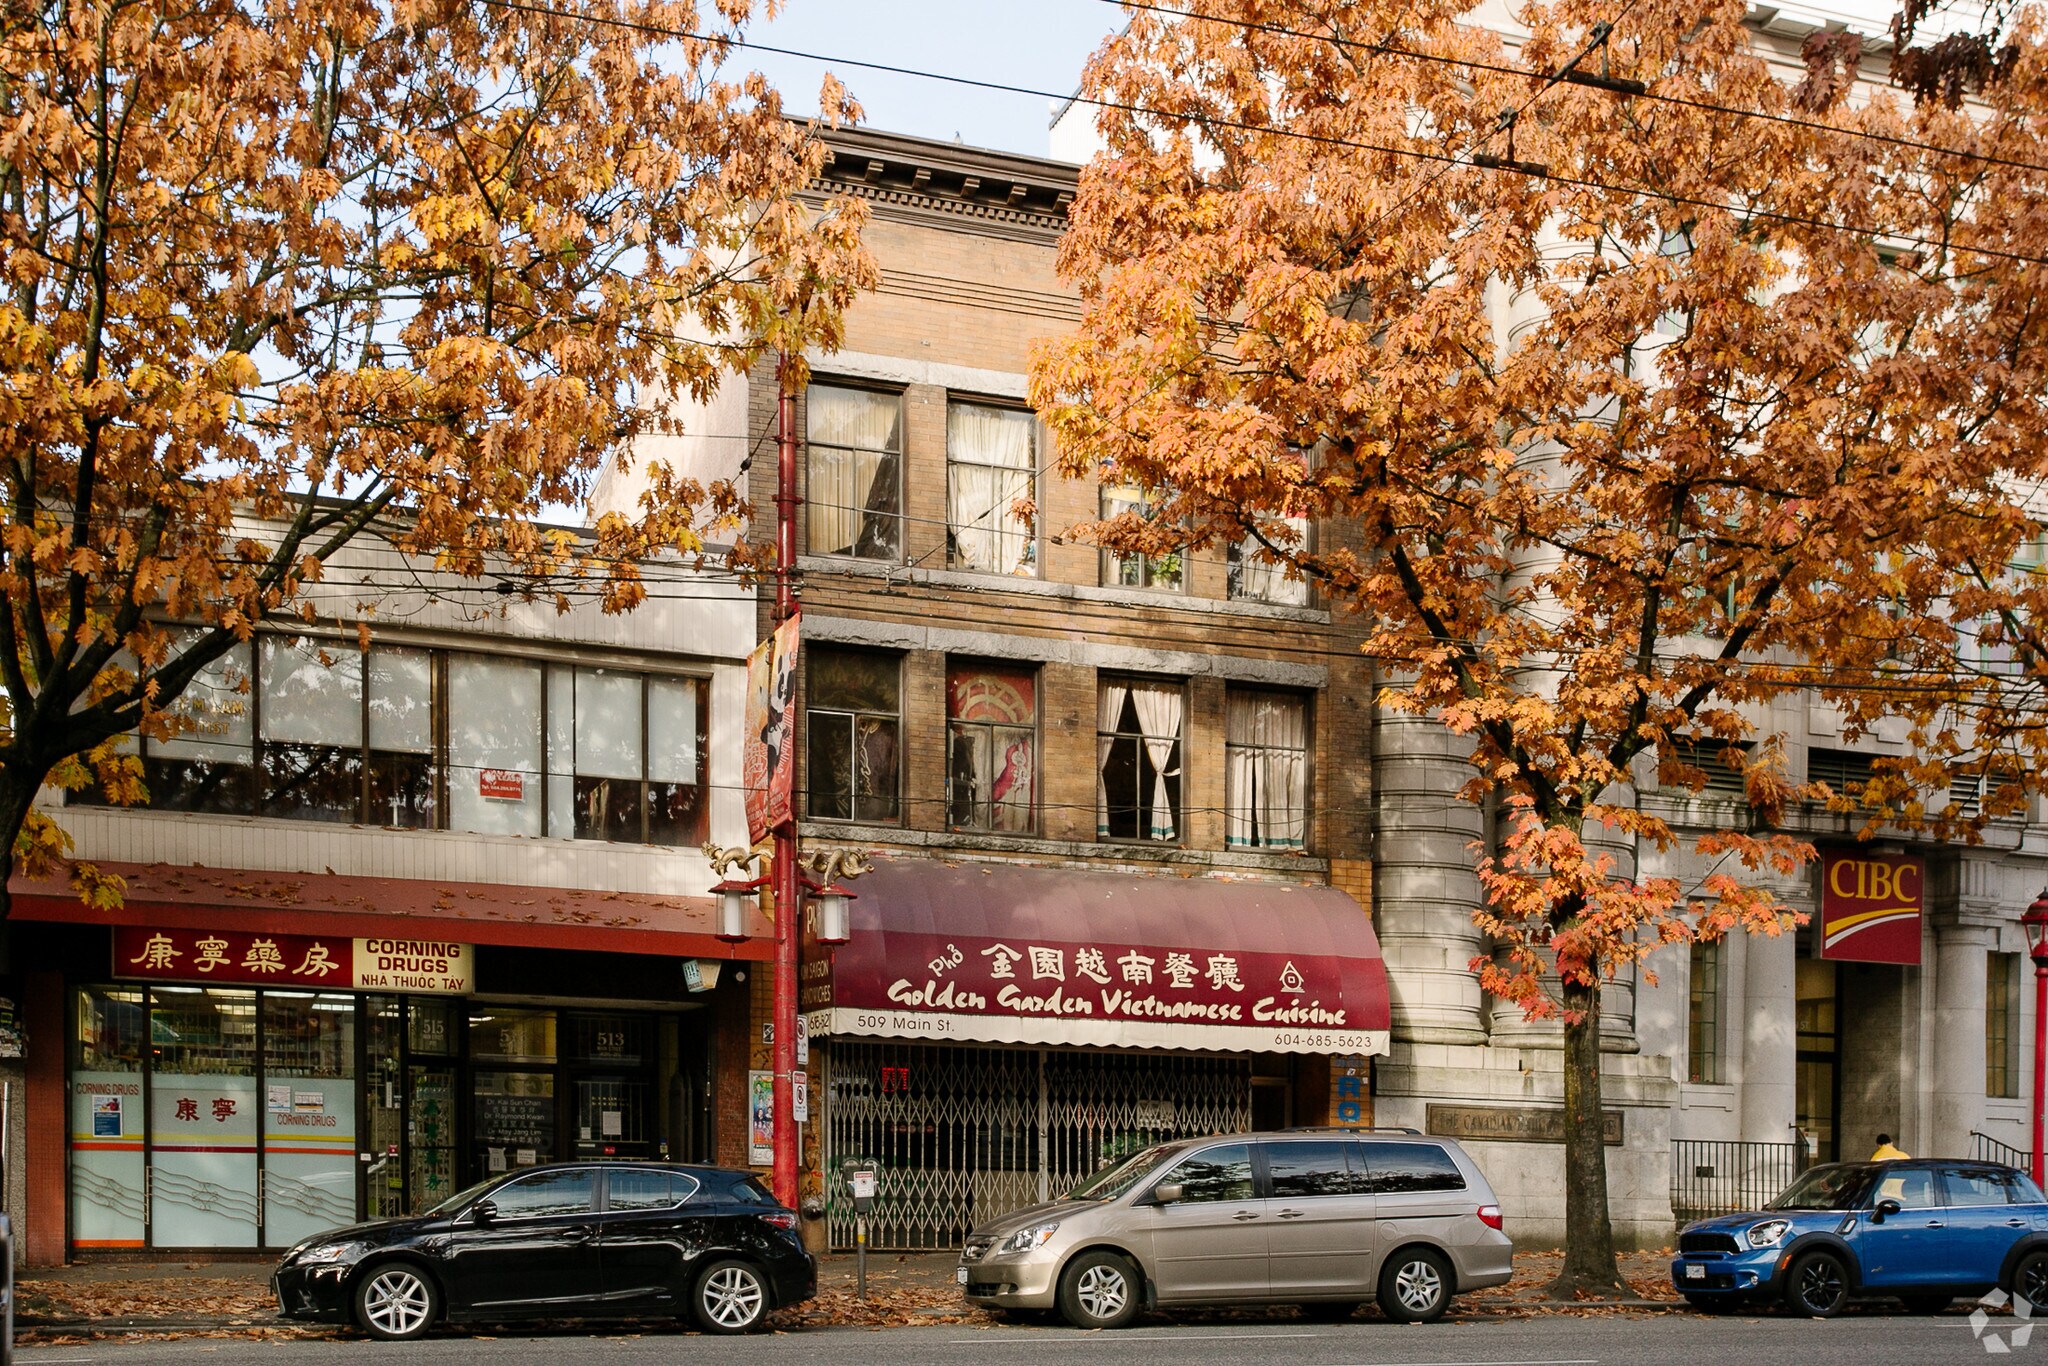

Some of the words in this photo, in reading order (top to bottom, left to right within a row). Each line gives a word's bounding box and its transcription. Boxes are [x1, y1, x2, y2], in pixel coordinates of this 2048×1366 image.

[1830, 859, 1918, 903] CIBC
[130, 932, 340, 977] 康寧藥房
[366, 939, 461, 958] CORNING
[378, 956, 448, 974] DRUGS
[980, 942, 1245, 992] 金園越南餐廳
[887, 978, 986, 1010] Golden
[996, 984, 1093, 1015] Garden
[1101, 989, 1243, 1021] Vietnamese
[1252, 996, 1346, 1025] Cuisine
[423, 1019, 444, 1034] 515
[857, 1015, 886, 1028] 509
[893, 1017, 931, 1031] Main
[937, 1019, 955, 1032] St.
[597, 1031, 624, 1046] 513
[1274, 1033, 1372, 1048] 604-685-5623
[76, 1083, 111, 1095] CORNING
[113, 1083, 139, 1096] DRUGS
[175, 1097, 237, 1122] 康寧
[276, 1113, 310, 1126] CORNING
[311, 1115, 337, 1128] DRUGS
[1439, 1113, 1458, 1130] THE
